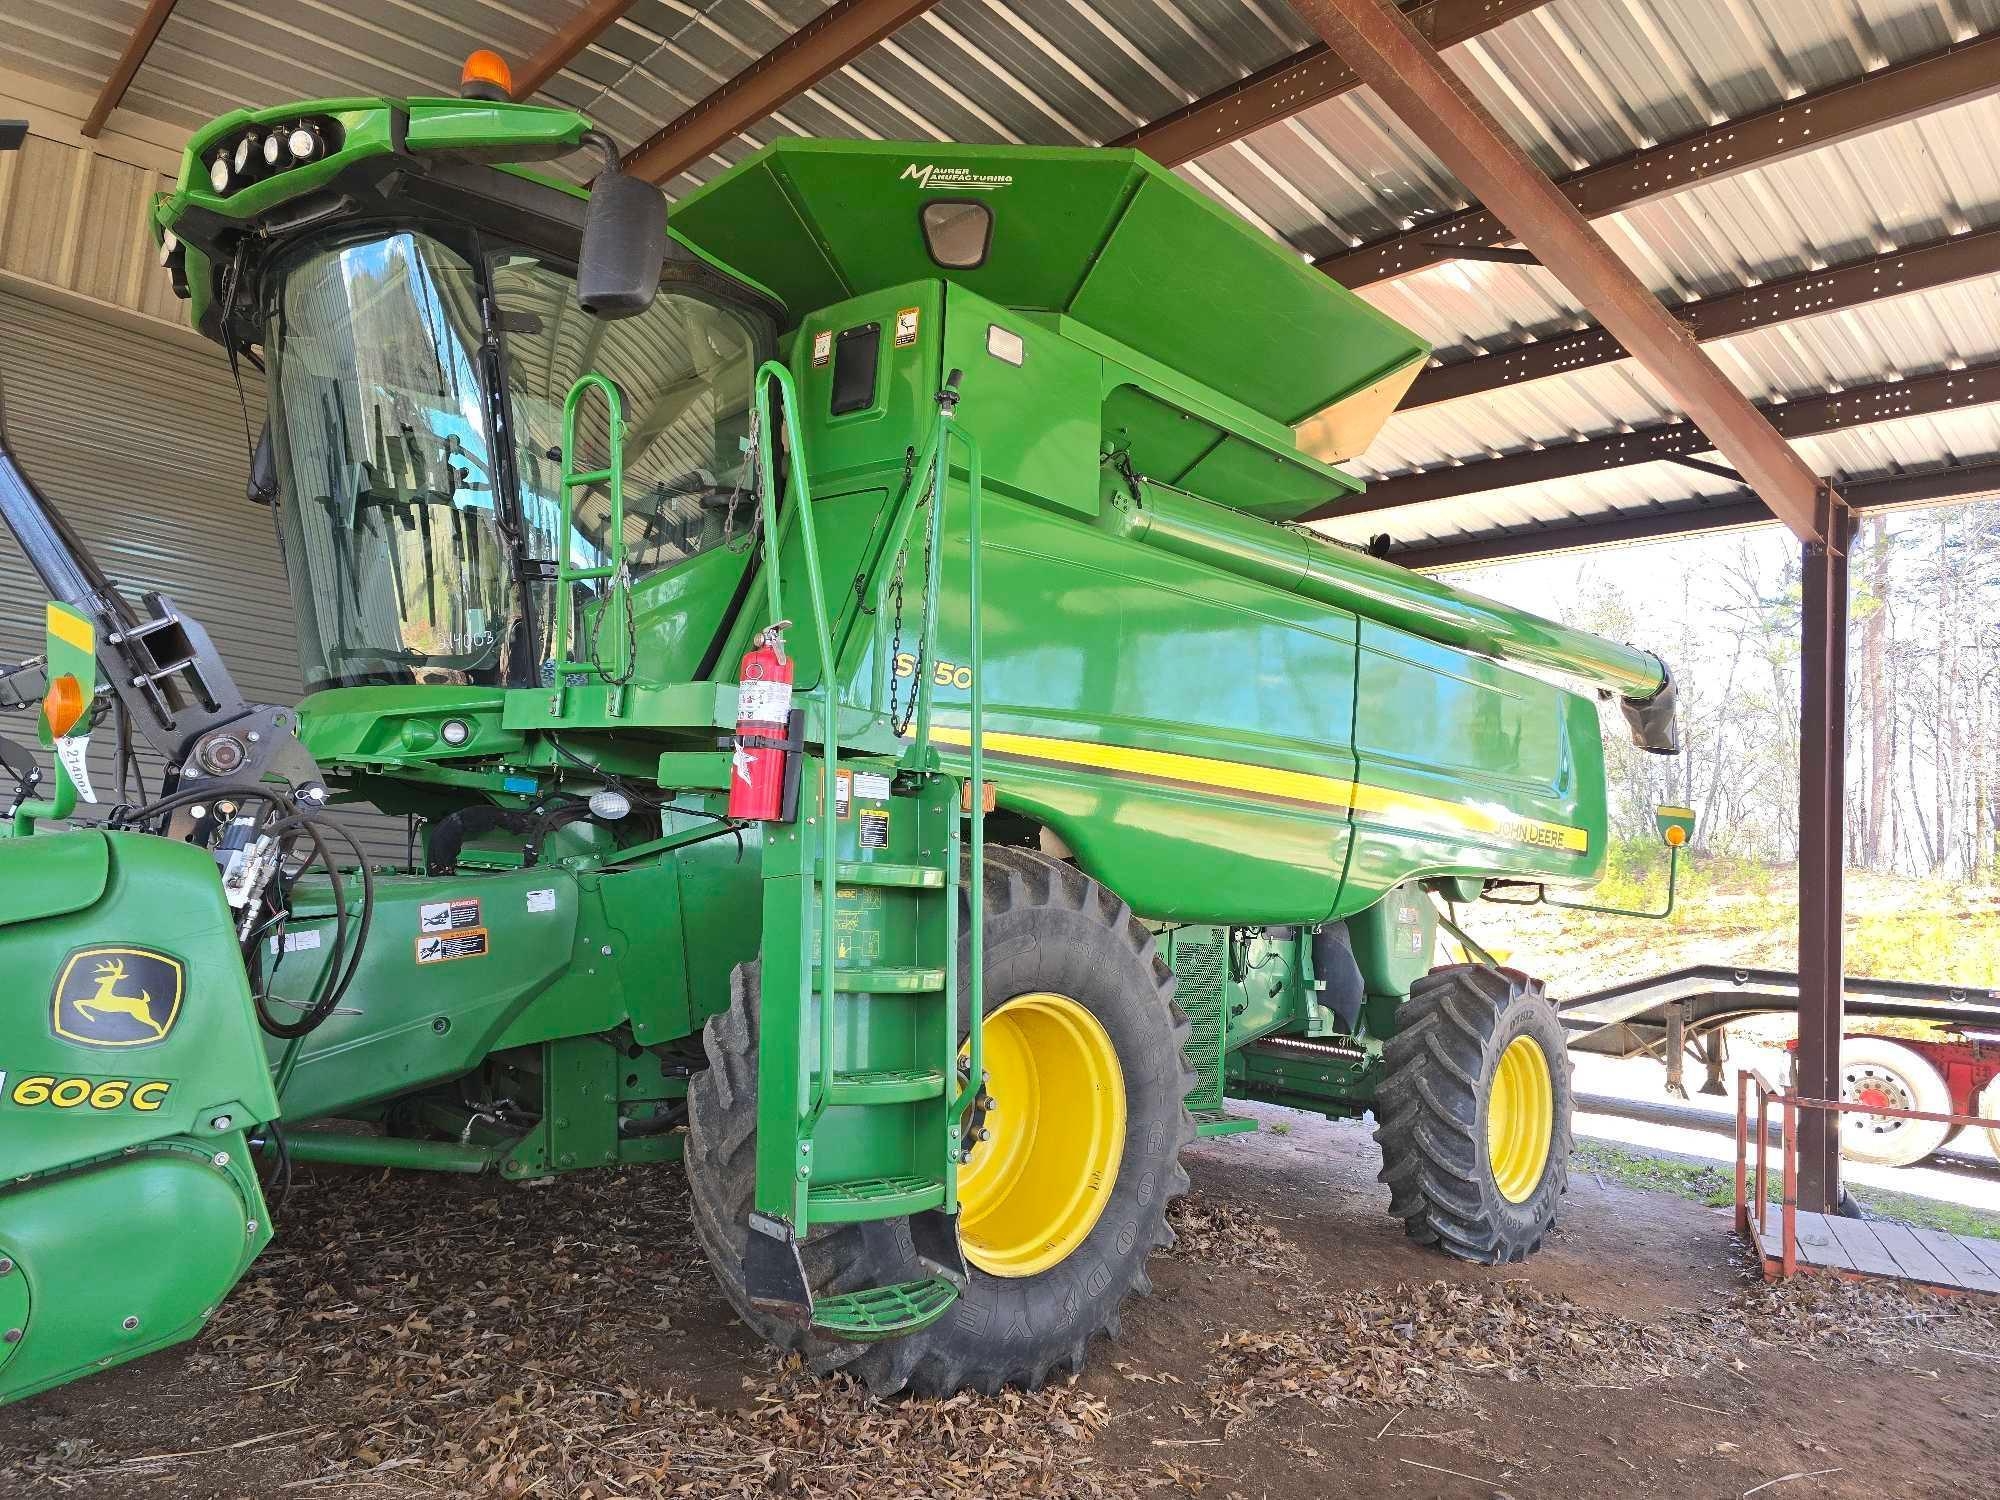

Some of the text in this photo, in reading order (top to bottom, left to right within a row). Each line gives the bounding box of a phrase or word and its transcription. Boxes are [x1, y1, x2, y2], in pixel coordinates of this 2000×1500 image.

[894, 652, 973, 690] S50
[1496, 821, 1564, 848] JOHN DEERE
[11, 1075, 172, 1112] 606C
